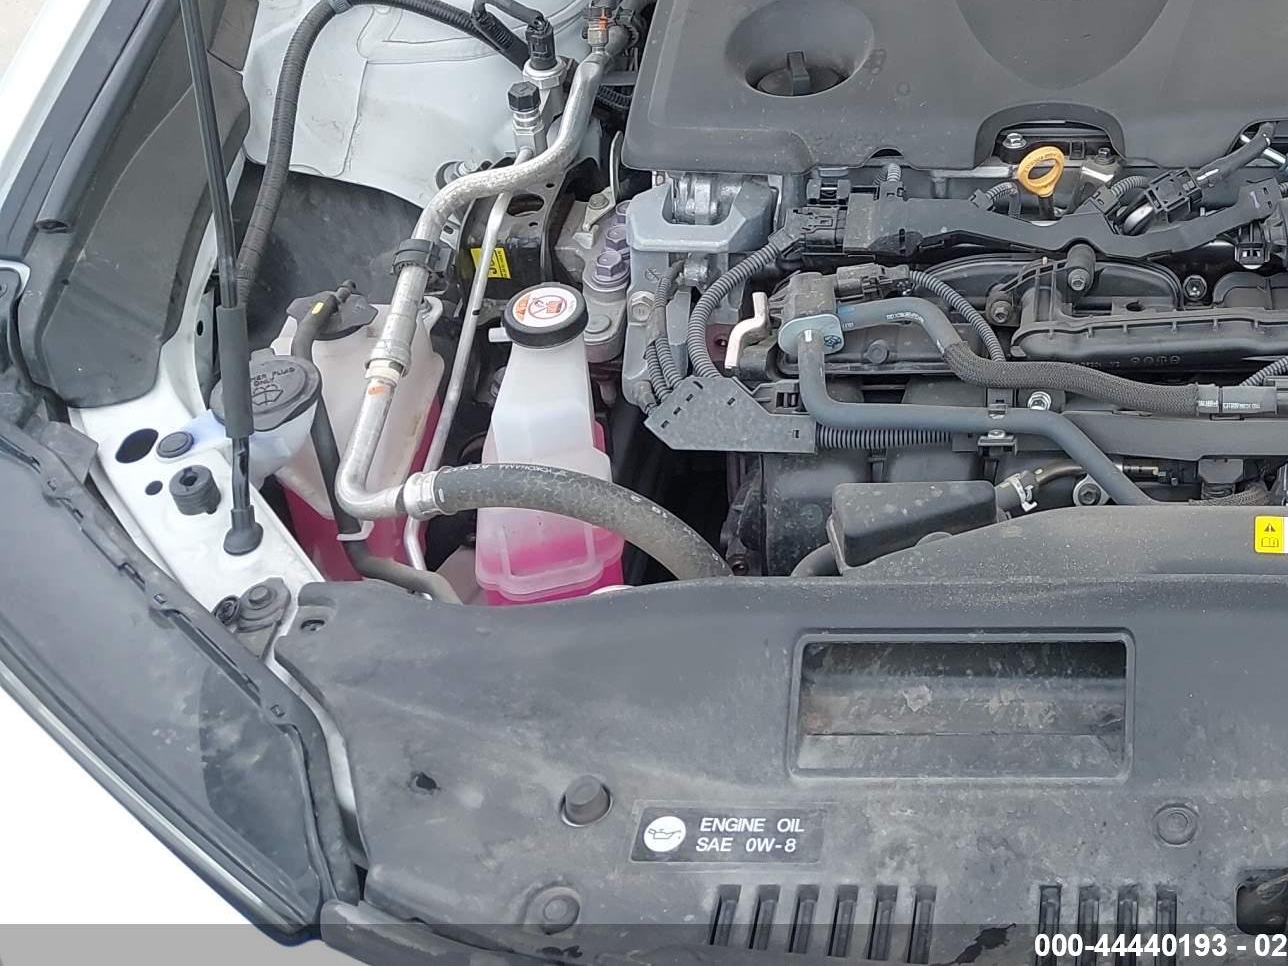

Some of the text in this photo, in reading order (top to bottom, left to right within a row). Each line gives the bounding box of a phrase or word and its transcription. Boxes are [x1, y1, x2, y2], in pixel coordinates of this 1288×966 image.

[700, 817, 805, 832] ENGINE OIL
[695, 837, 797, 852] SAE 0W-8
